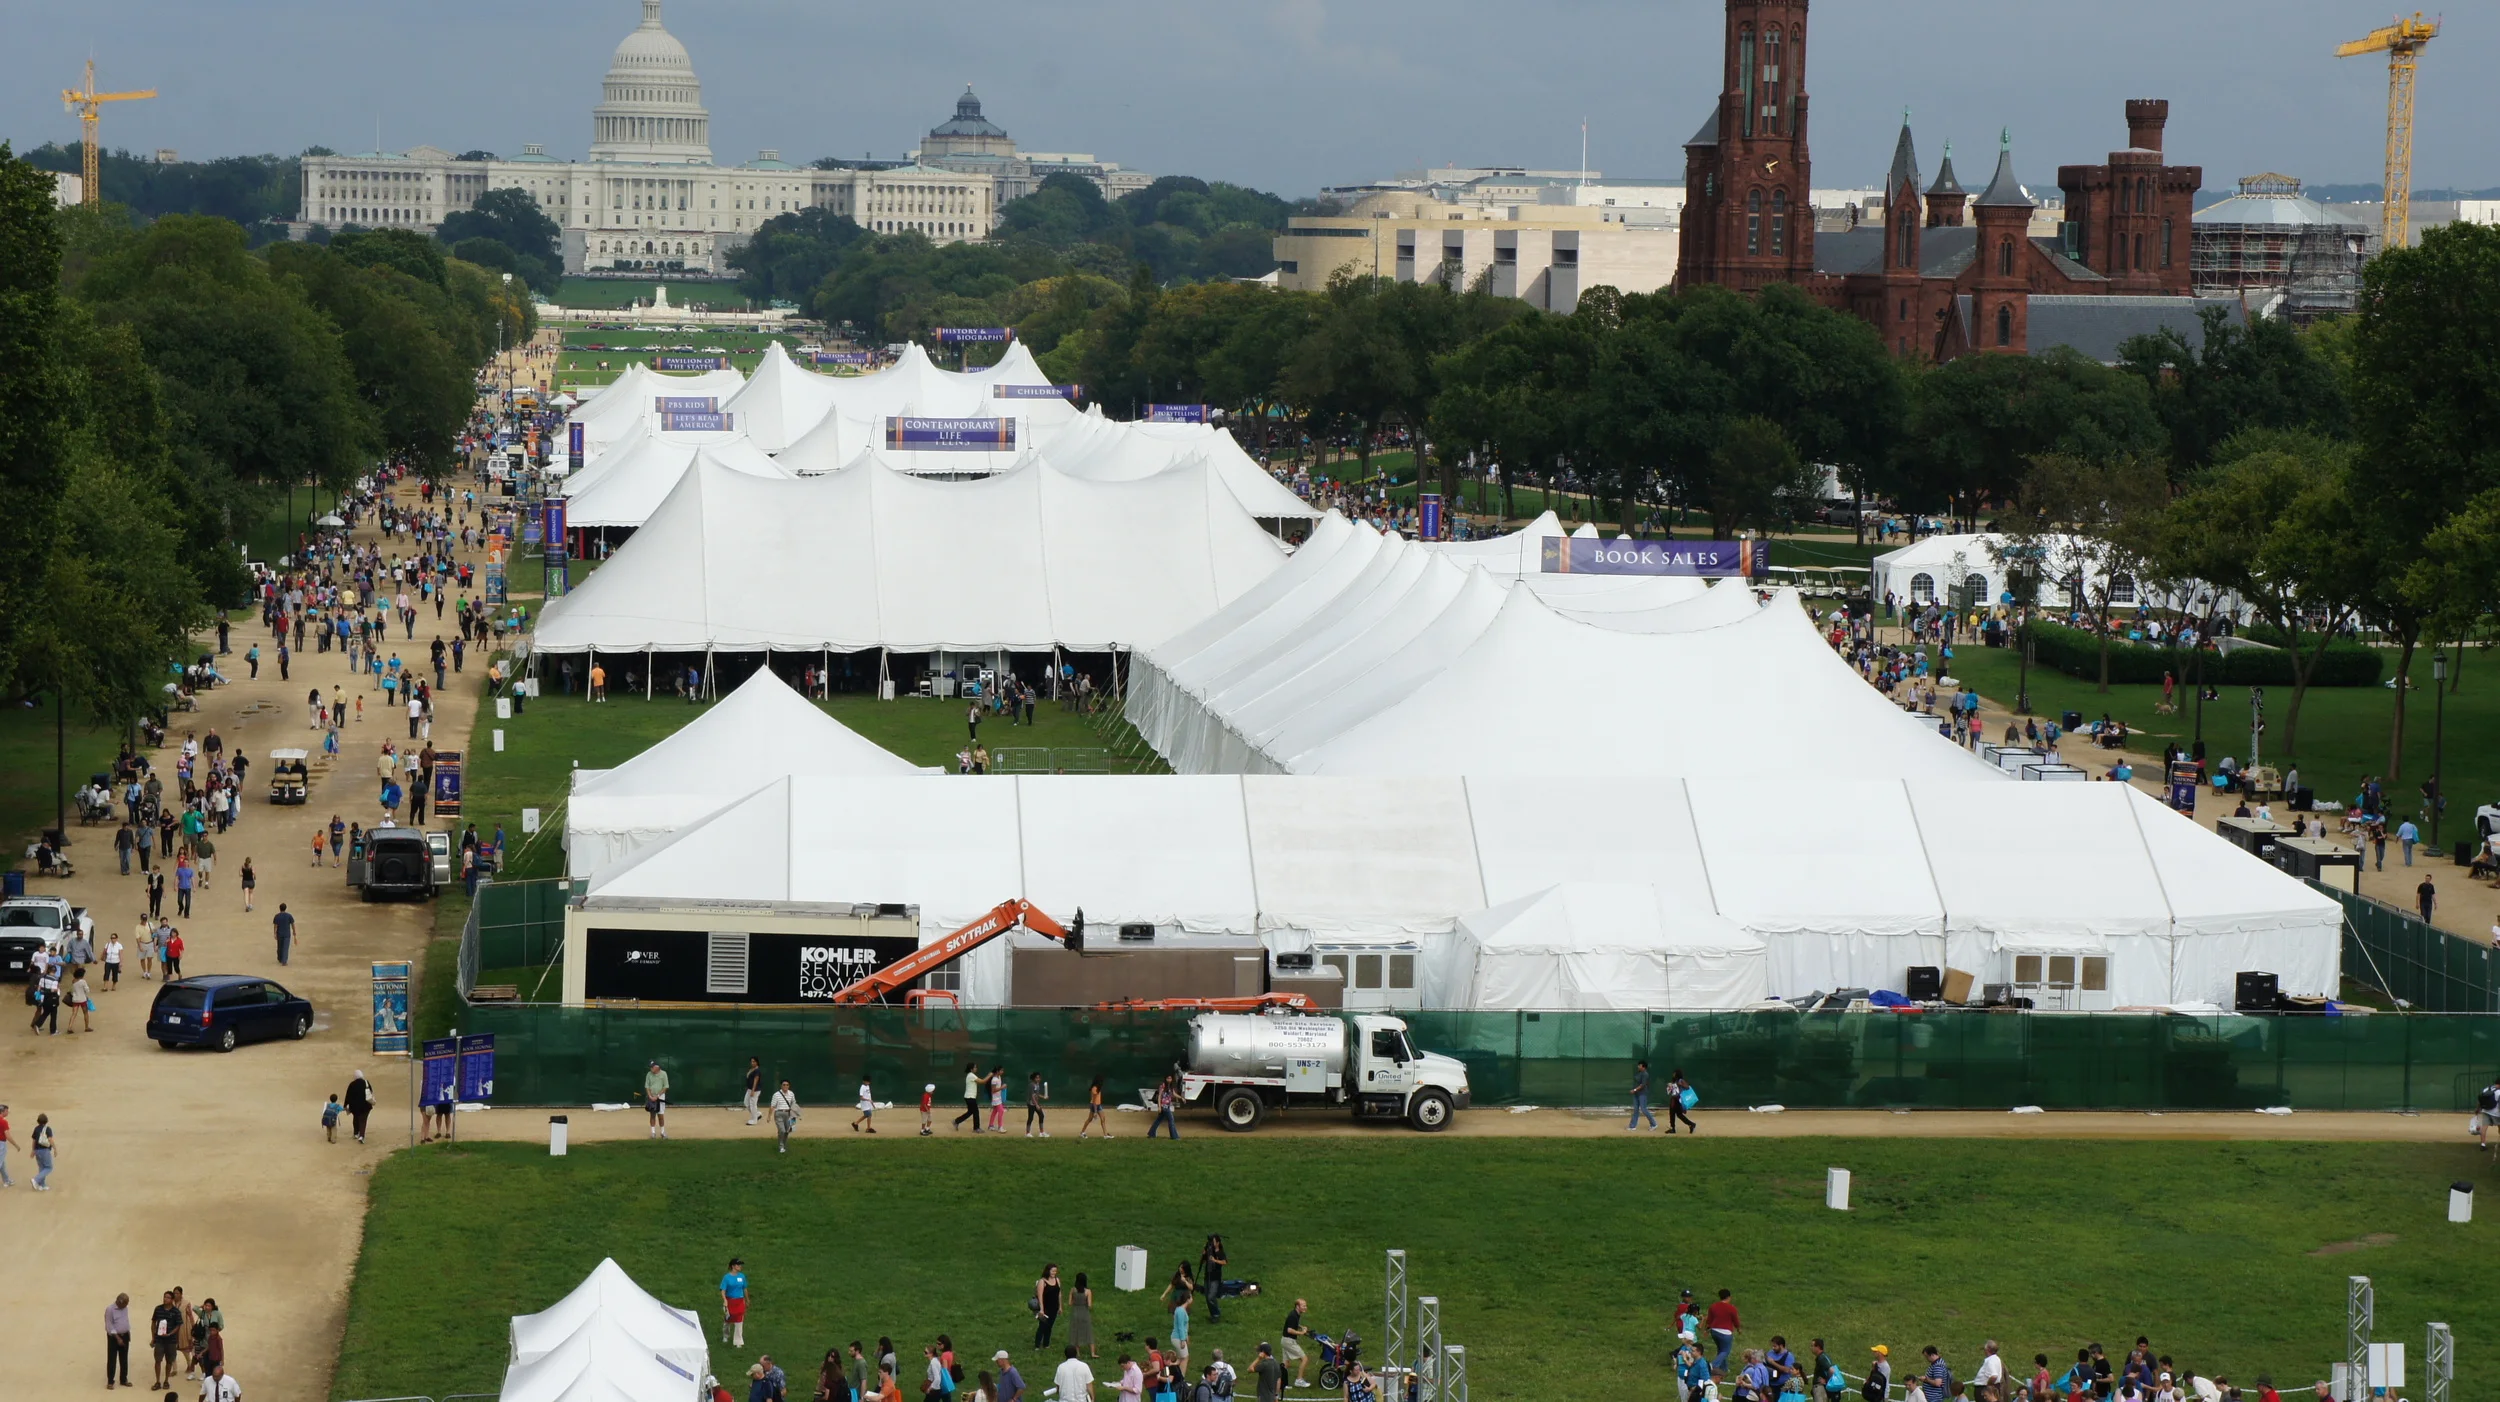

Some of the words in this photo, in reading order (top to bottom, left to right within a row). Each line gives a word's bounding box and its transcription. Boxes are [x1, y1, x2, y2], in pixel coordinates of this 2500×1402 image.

[905, 420, 996, 430] CONTEMPORARY
[940, 431, 962, 440] LIFE
[1594, 550, 1655, 565] BOOK
[1661, 551, 1718, 566] SALES
[946, 917, 997, 952] SKYTRAK
[801, 947, 877, 964] KOHLER
[1296, 1060, 1321, 1068] UNS-2
